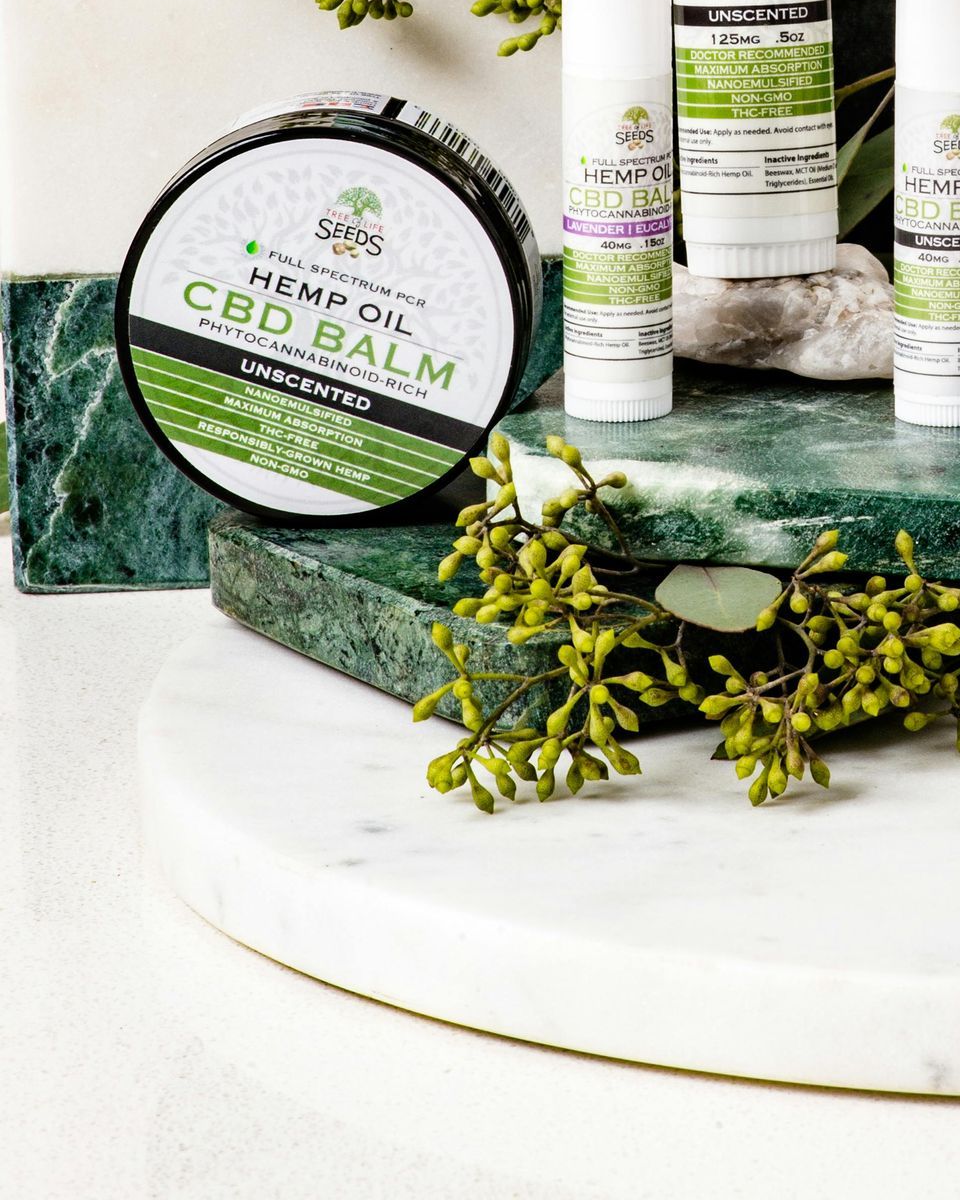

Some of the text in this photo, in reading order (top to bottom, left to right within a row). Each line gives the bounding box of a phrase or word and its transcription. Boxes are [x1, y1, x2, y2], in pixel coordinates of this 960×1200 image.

[709, 7, 808, 22] UNSCENTED
[691, 46, 824, 60] DOCTOR RECOMMENDED
[695, 60, 822, 74] MAXIMUM ABSORPTION
[708, 76, 812, 89] NANOEMULSIFIED
[732, 93, 792, 103] NON-GMO
[732, 107, 793, 117] THC-FREE
[616, 130, 654, 145] SEEDS
[714, 128, 732, 136] Apply
[743, 127, 772, 135] needed.
[585, 168, 647, 184] HEMP
[652, 163, 671, 181] OIL
[722, 170, 740, 178] Hemp
[912, 166, 934, 175] FULL
[326, 209, 384, 232] TREE LIFE
[568, 220, 624, 234] LAVENDER
[315, 218, 384, 256] SEEDS
[269, 251, 426, 308] FULL SPECTRUM PCR
[609, 283, 660, 294] NON-GMO
[249, 267, 413, 336] HEMP OIL
[608, 294, 660, 304] THC-FREE
[183, 281, 456, 390] CBD BALM
[199, 318, 428, 399] PHYTOCANNABINOID-RICH
[240, 358, 371, 411] UNSCENTED
[245, 386, 352, 426] NANOEMULSIFIED
[224, 396, 363, 447] MAXIMUM ABSORPTION
[260, 424, 319, 450] THC-FREE
[198, 421, 370, 482] RESPONSIBLY-GROWN HEMP
[250, 454, 309, 479] NON-GMO
